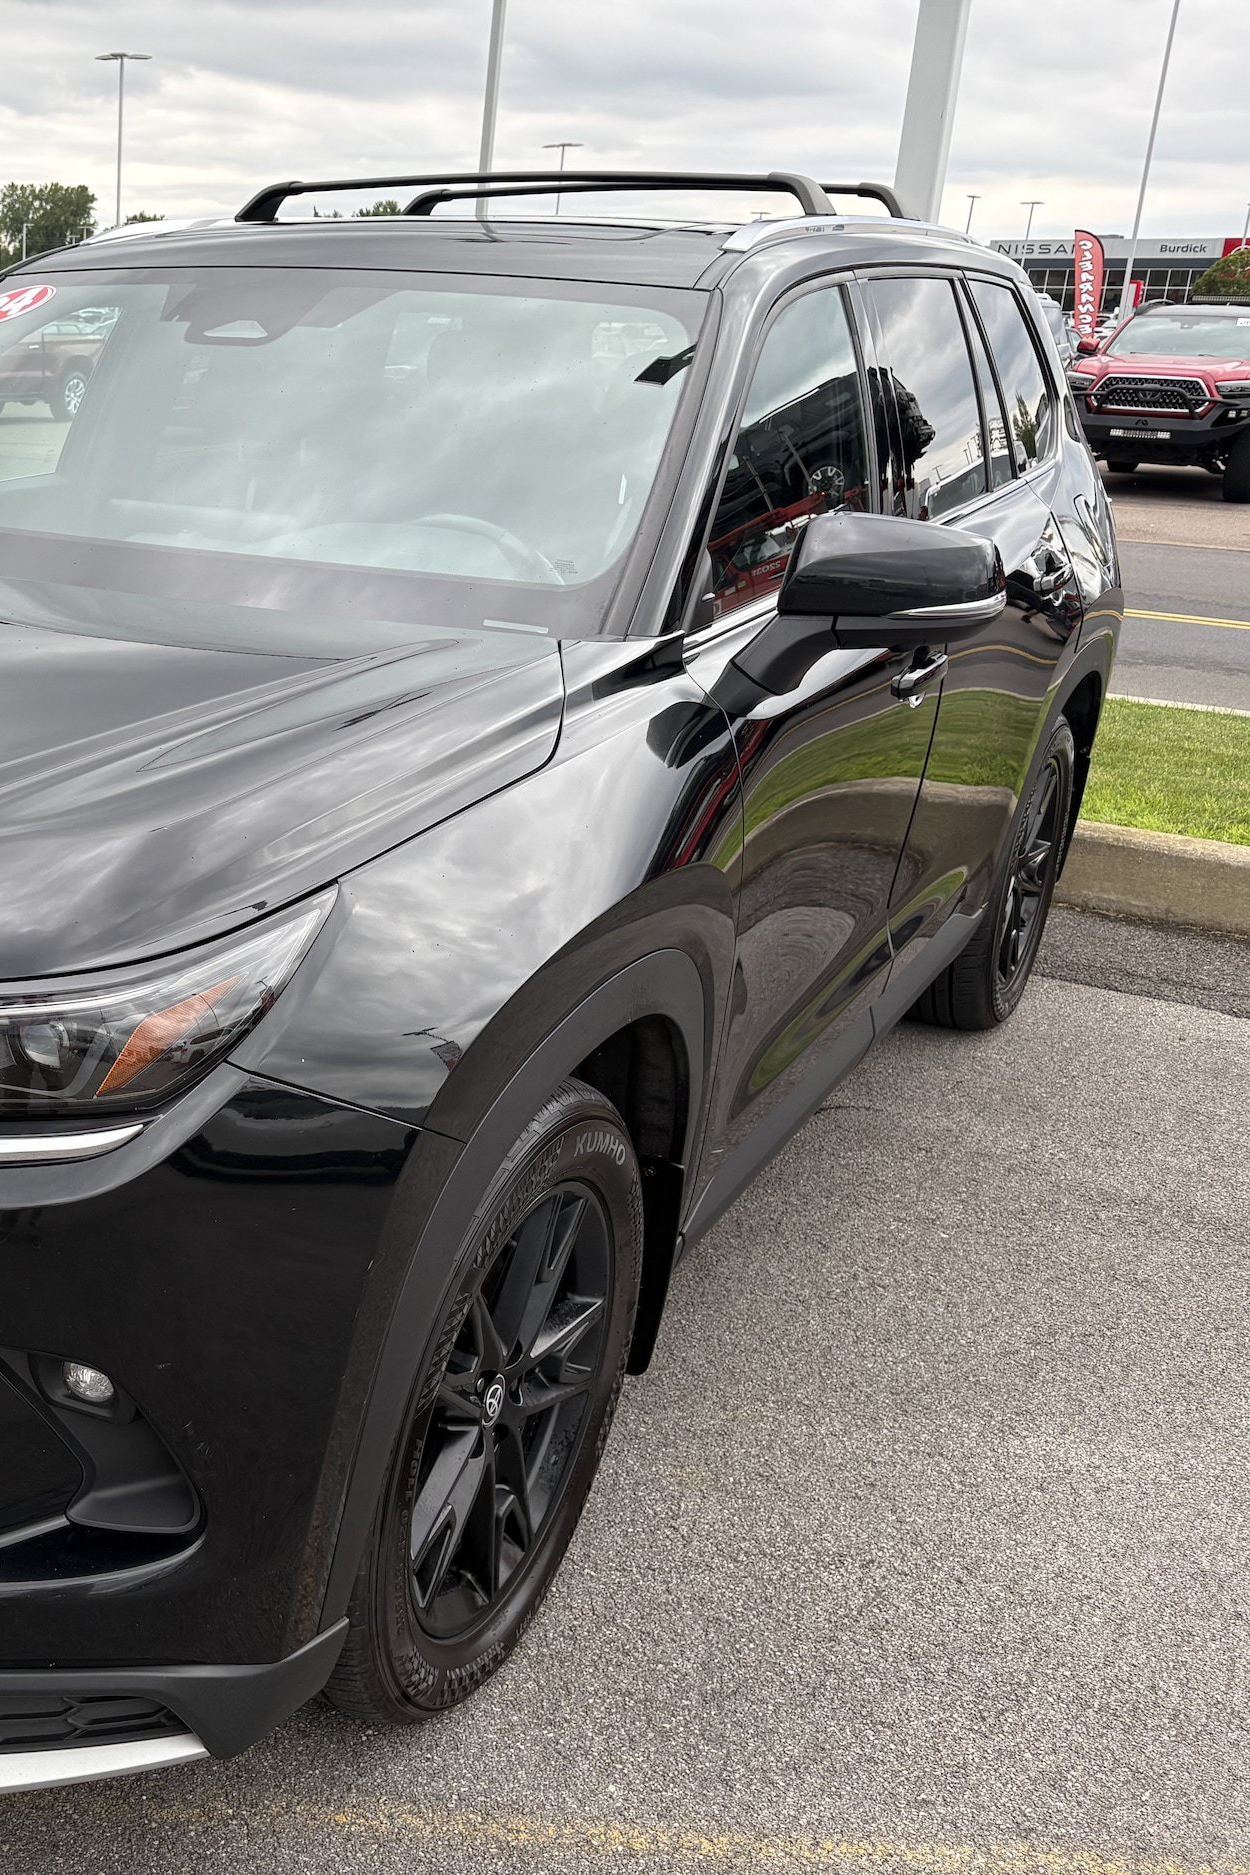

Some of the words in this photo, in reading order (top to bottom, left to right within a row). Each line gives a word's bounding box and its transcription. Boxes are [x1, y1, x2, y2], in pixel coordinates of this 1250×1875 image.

[997, 244, 1075, 255] NISSA
[1159, 244, 1207, 253] Burdick
[573, 1131, 626, 1166] KUMHO
